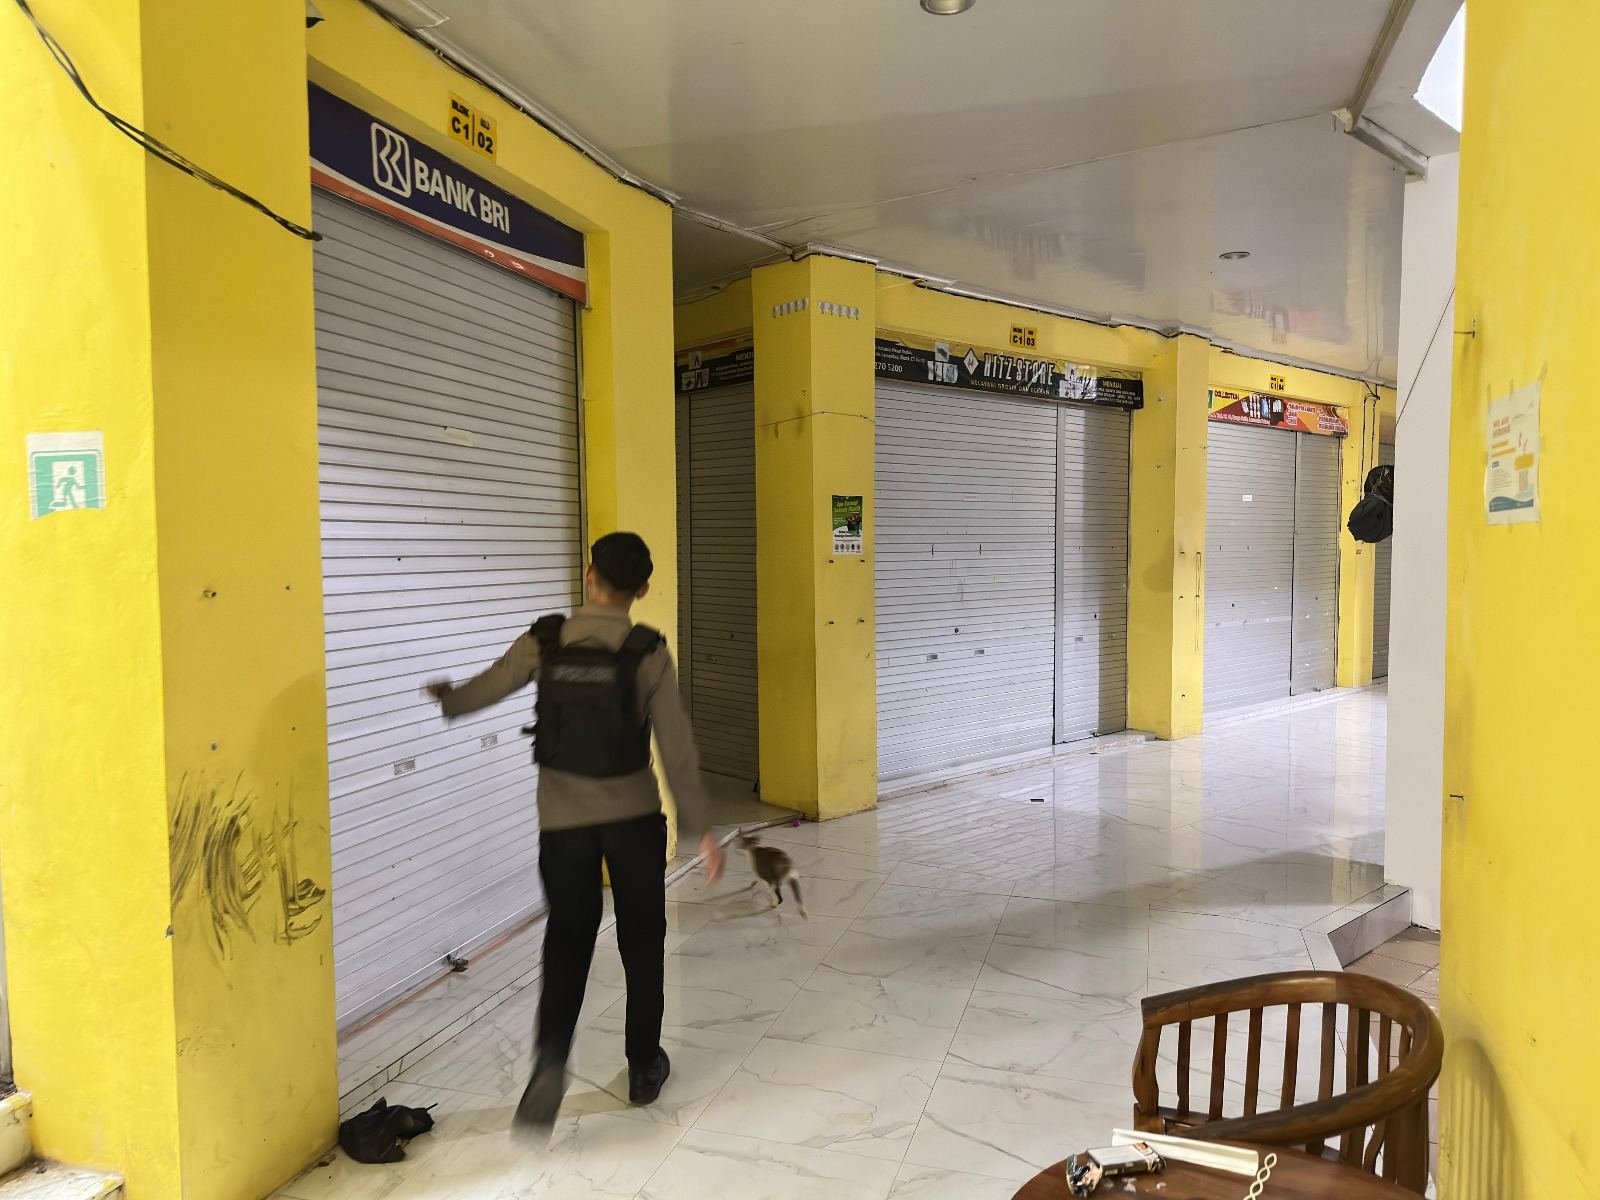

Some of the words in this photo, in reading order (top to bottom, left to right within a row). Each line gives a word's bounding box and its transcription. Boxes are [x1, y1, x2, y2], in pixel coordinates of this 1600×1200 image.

[451, 116, 469, 140] C1
[477, 132, 494, 154] 02
[414, 158, 477, 217] BANK
[480, 192, 510, 234] BRI
[1013, 335, 1022, 344] C1
[1027, 337, 1035, 346] 03
[887, 363, 903, 373] 5200
[983, 353, 1013, 380] HITZ
[1016, 357, 1055, 386] STORE
[970, 379, 996, 389] MELAYANI
[1214, 390, 1240, 400] COLLECTION
